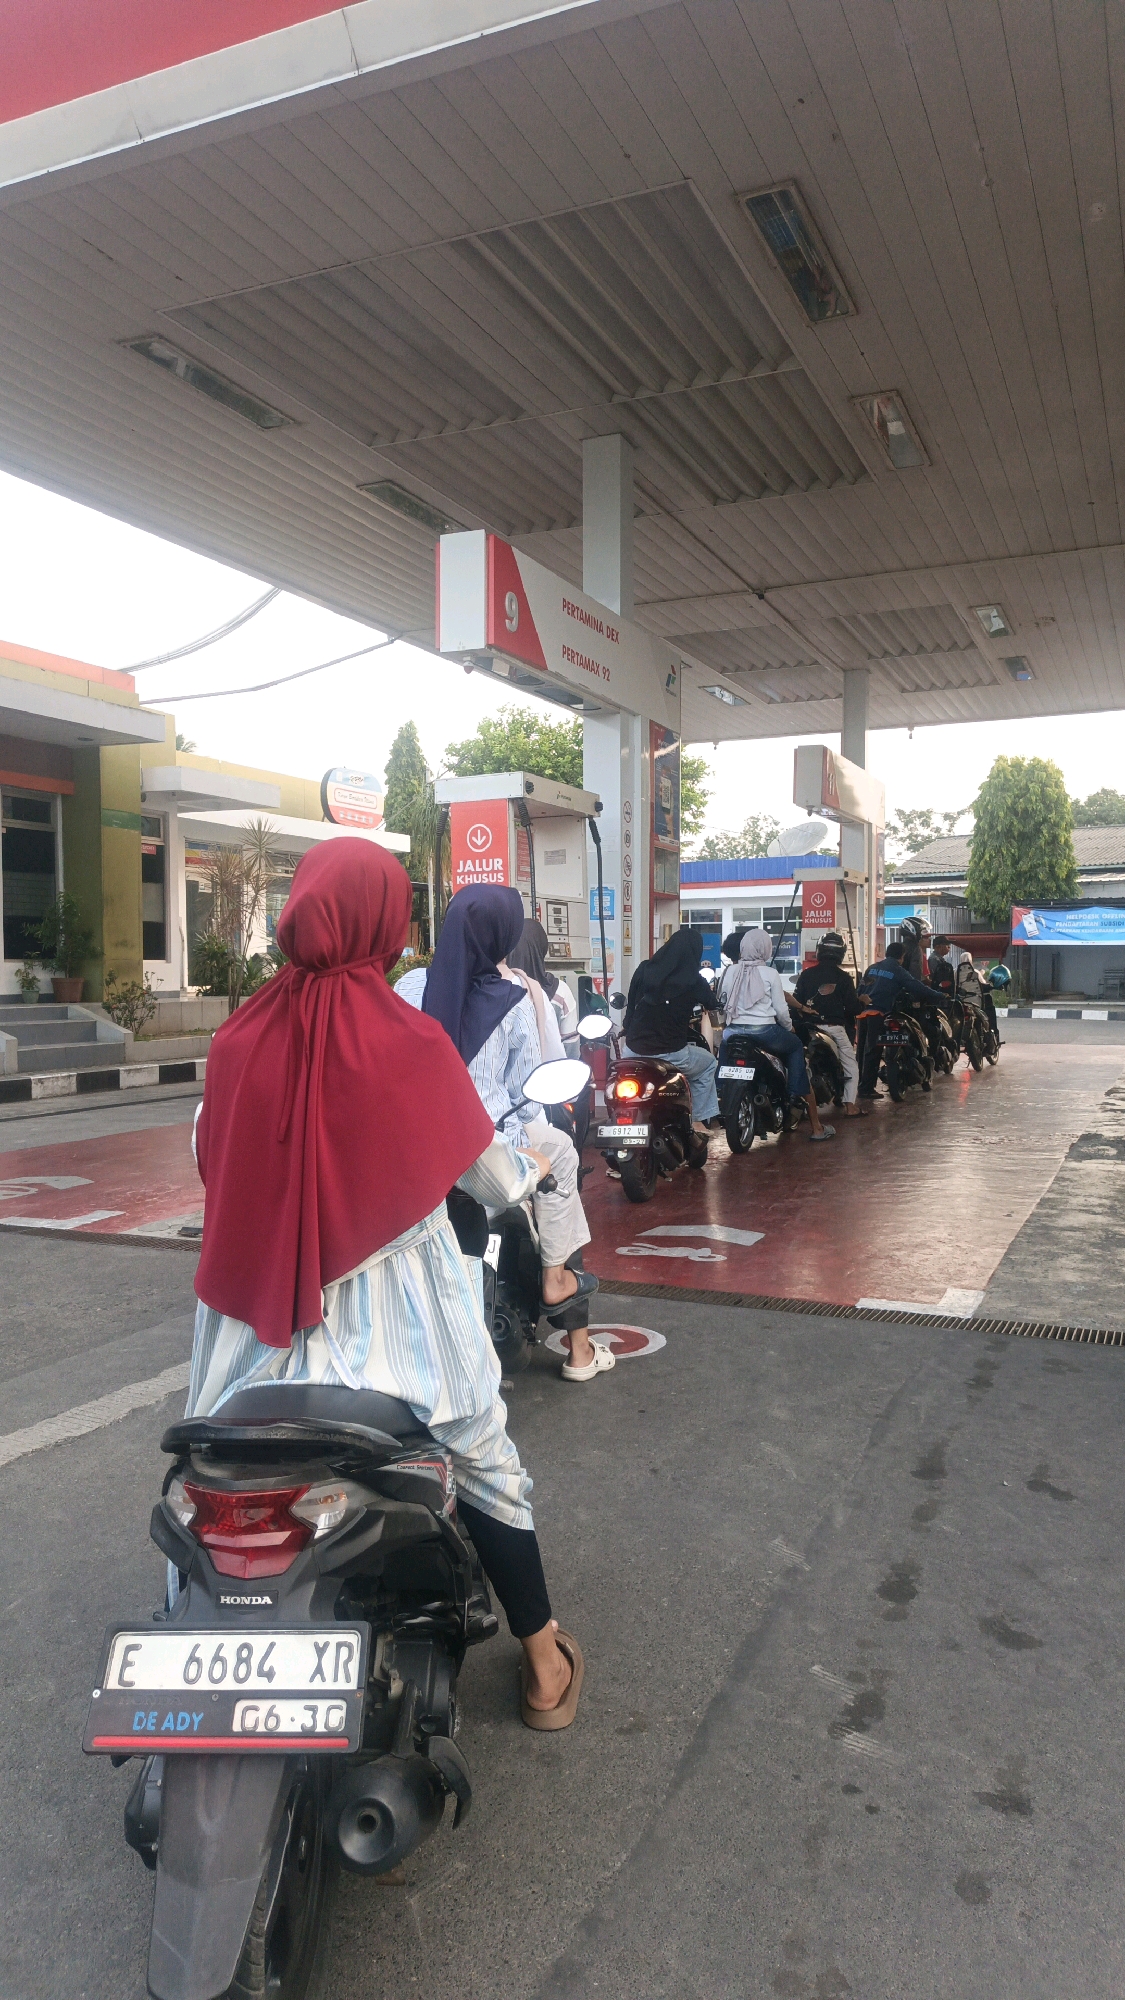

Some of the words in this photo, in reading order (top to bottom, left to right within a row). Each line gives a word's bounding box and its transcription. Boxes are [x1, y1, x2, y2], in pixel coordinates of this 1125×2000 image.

[505, 591, 519, 632] 9
[562, 597, 604, 635] PERTAMINA
[606, 625, 620, 644] DEX
[562, 644, 601, 677] PERTAMAX
[602, 665, 611, 682] 92
[456, 858, 504, 873] JALUR
[456, 872, 505, 884] KHUSUS
[805, 910, 832, 918] JALUR
[599, 1127, 605, 1136] E
[612, 1127, 632, 1135] 6912
[637, 1127, 646, 1136] VL
[220, 1595, 273, 1605] HONDA
[117, 1643, 142, 1688] E
[182, 1641, 277, 1685] 6684
[309, 1641, 354, 1684] XR
